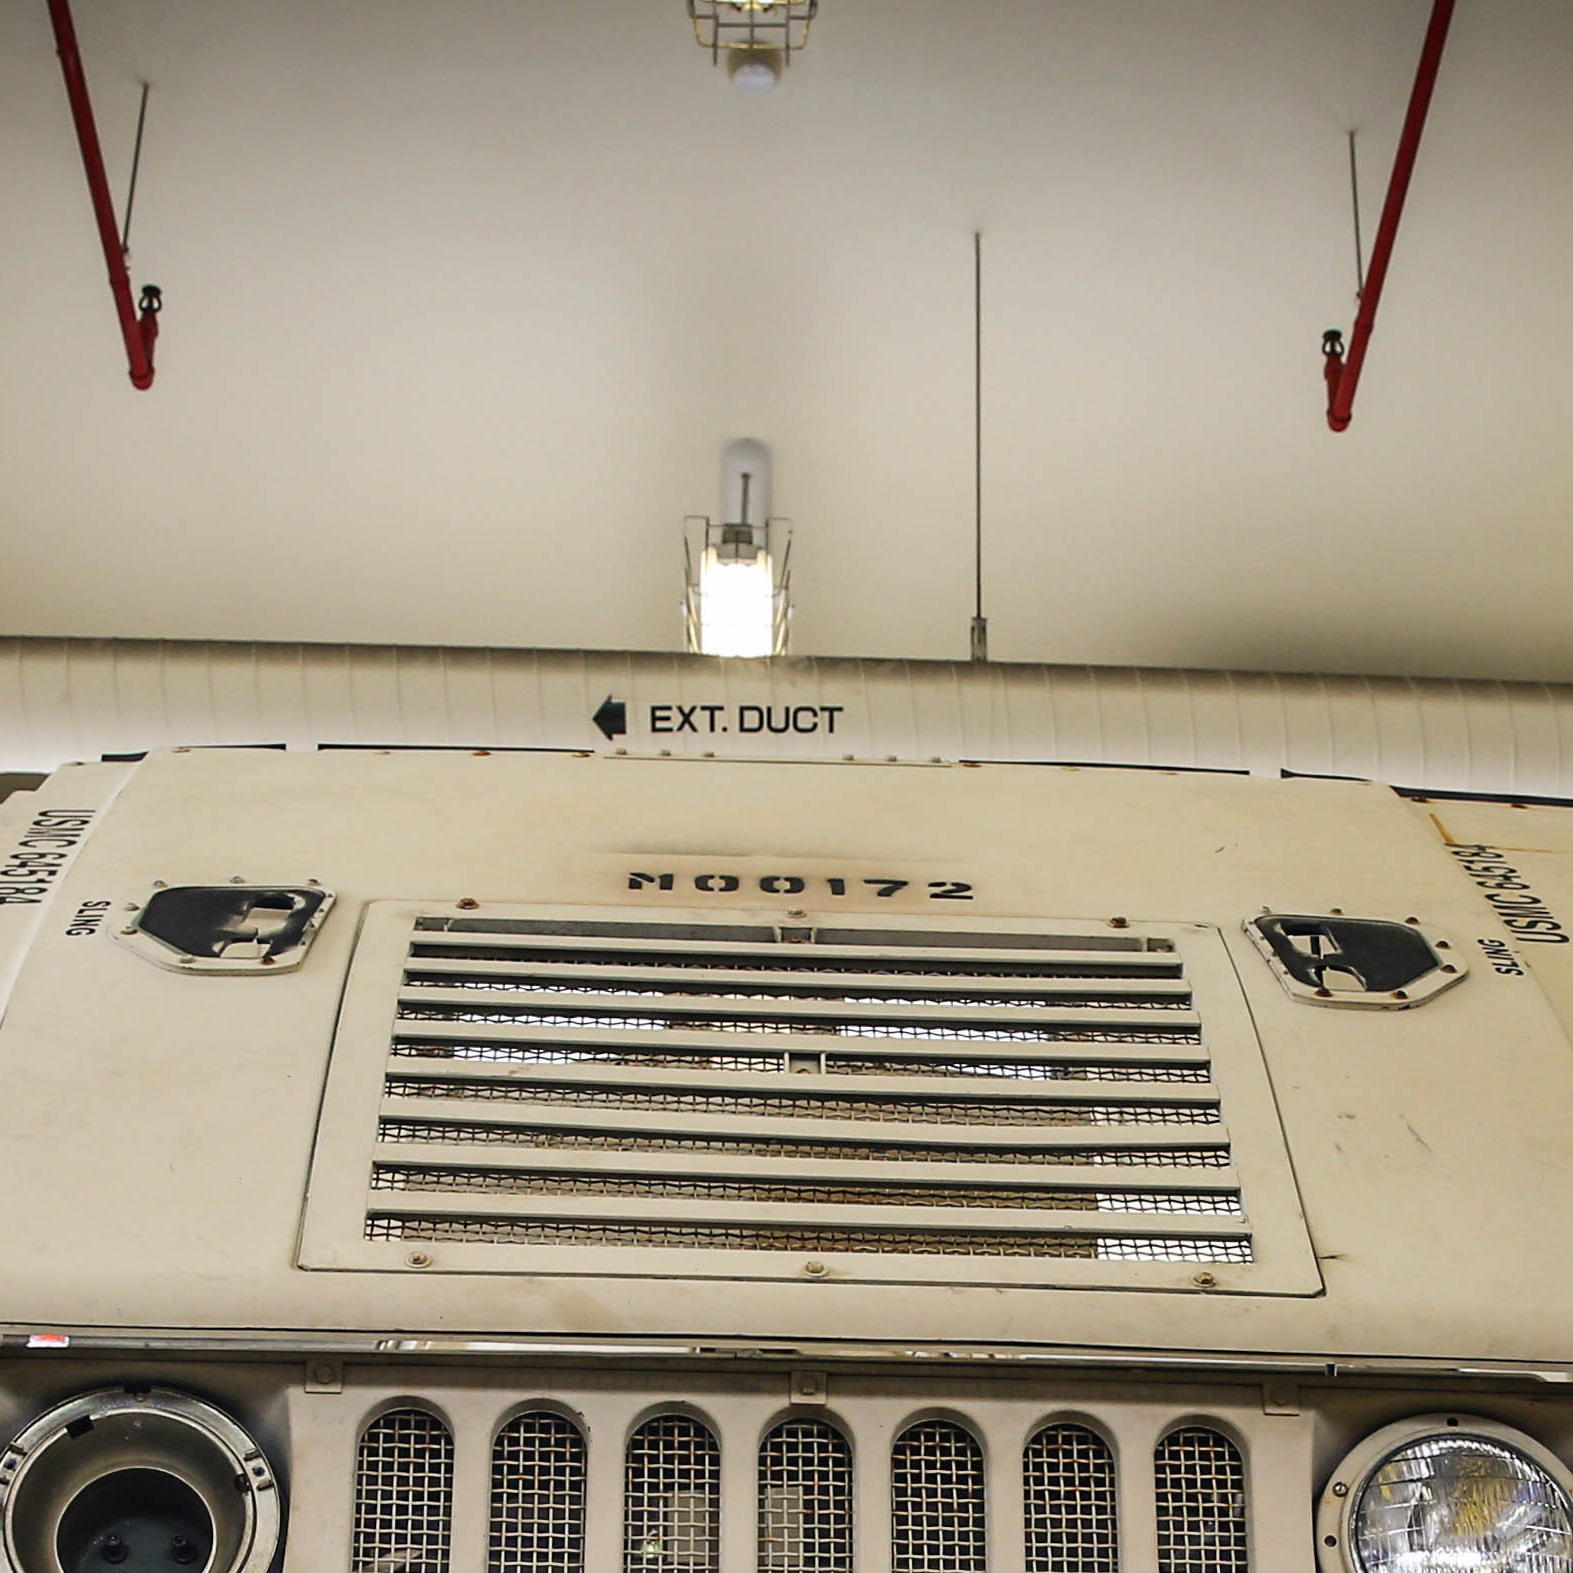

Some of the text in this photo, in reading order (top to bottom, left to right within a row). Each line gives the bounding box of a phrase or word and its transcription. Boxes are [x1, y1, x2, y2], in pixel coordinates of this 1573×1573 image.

[650, 705, 844, 734] EXT. DUCT
[18, 808, 97, 849] USMC
[65, 899, 112, 937] SLING
[1483, 893, 1571, 944] USMC
[1477, 938, 1525, 977] SLING
